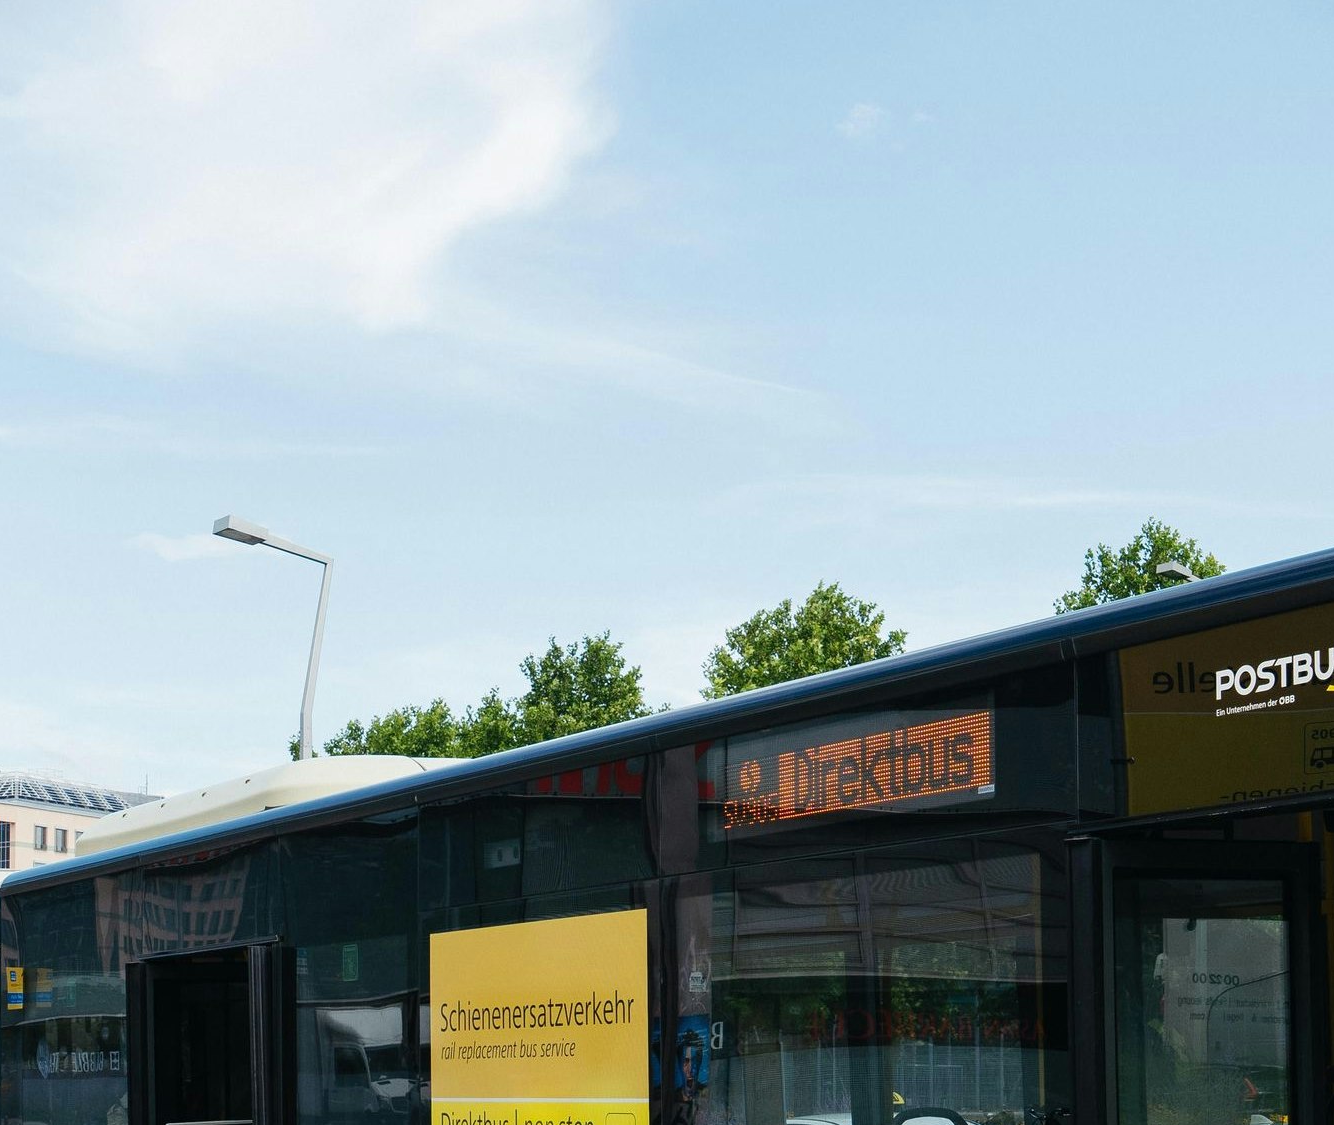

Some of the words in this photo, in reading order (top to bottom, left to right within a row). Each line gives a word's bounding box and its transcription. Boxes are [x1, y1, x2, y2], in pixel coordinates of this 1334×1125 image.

[1216, 709, 1226, 717] Ein
[1226, 701, 1267, 716] Unternehmen
[1267, 699, 1278, 708] der
[794, 728, 975, 810] Direktbus
[440, 989, 634, 1032] Schienenersatzverkehr
[441, 1042, 455, 1060] rail
[457, 1041, 517, 1064] replacement
[520, 1040, 537, 1058] bus
[540, 1037, 576, 1058] service
